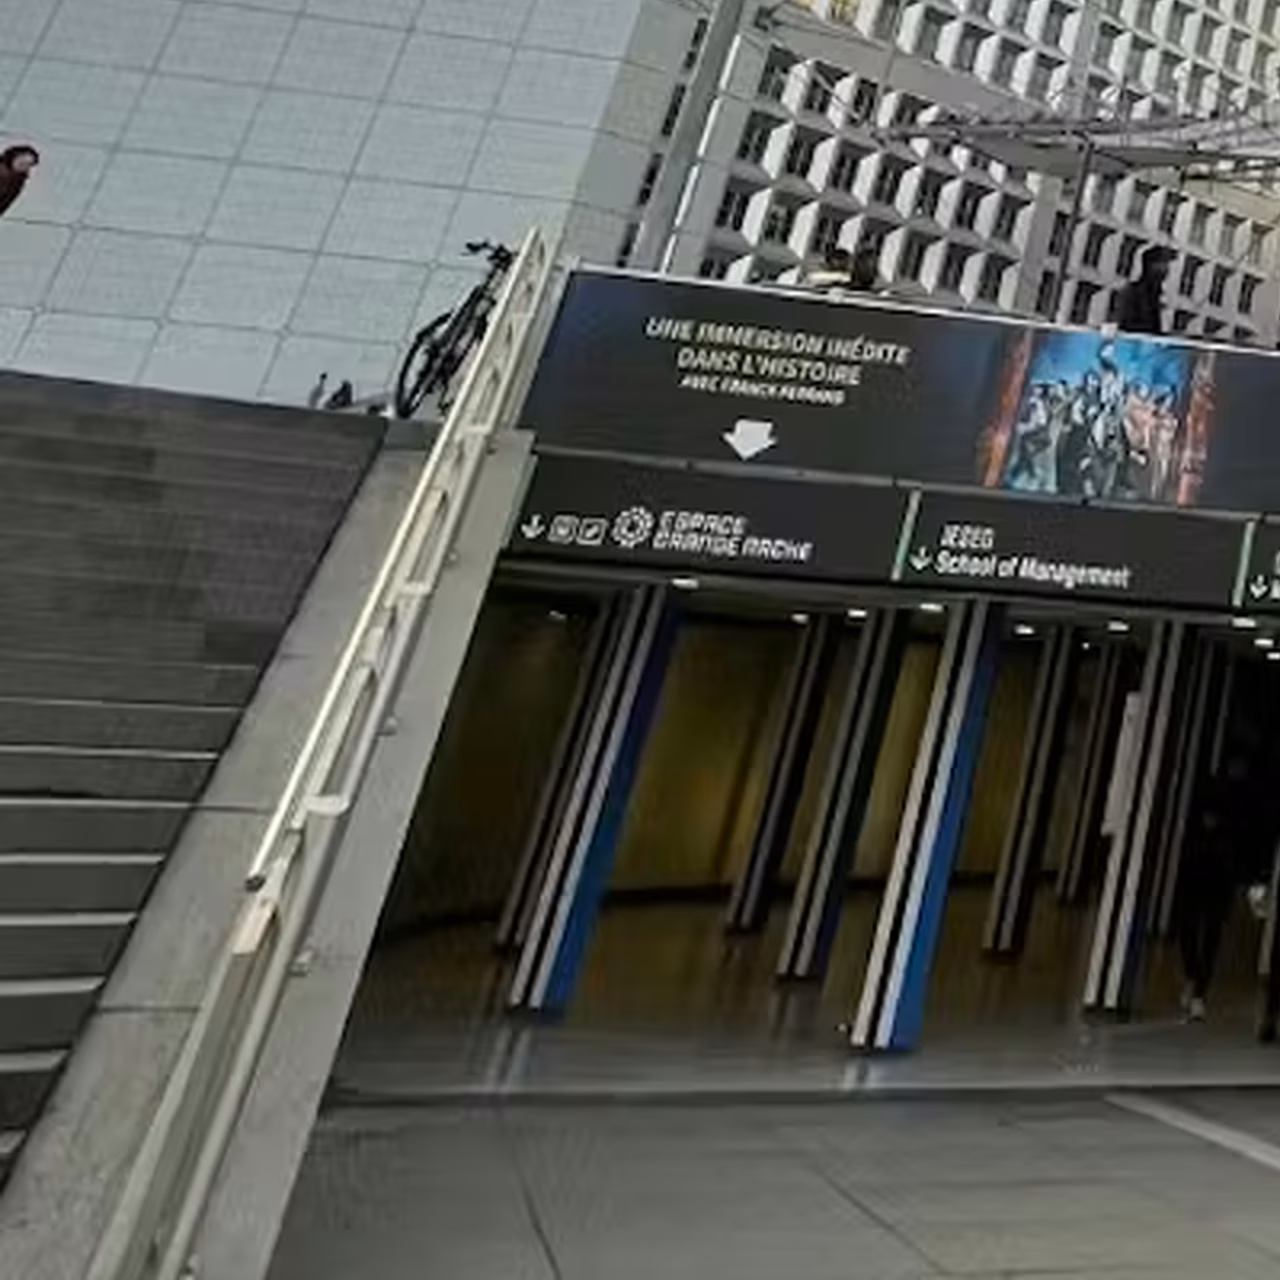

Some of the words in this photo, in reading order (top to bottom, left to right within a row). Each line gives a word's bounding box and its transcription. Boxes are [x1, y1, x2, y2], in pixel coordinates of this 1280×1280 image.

[646, 316, 695, 340] UNE
[697, 321, 824, 354] IMMERSION
[826, 334, 911, 365] INÉDITE
[677, 347, 741, 372] DANS
[742, 355, 863, 386] L'HISTOIRE
[659, 510, 747, 536] ESPACE
[652, 530, 741, 557] GRANDE
[741, 536, 814, 562] ARCHE
[934, 548, 997, 577] School
[998, 555, 1019, 578] of
[1019, 557, 1131, 589] Management
